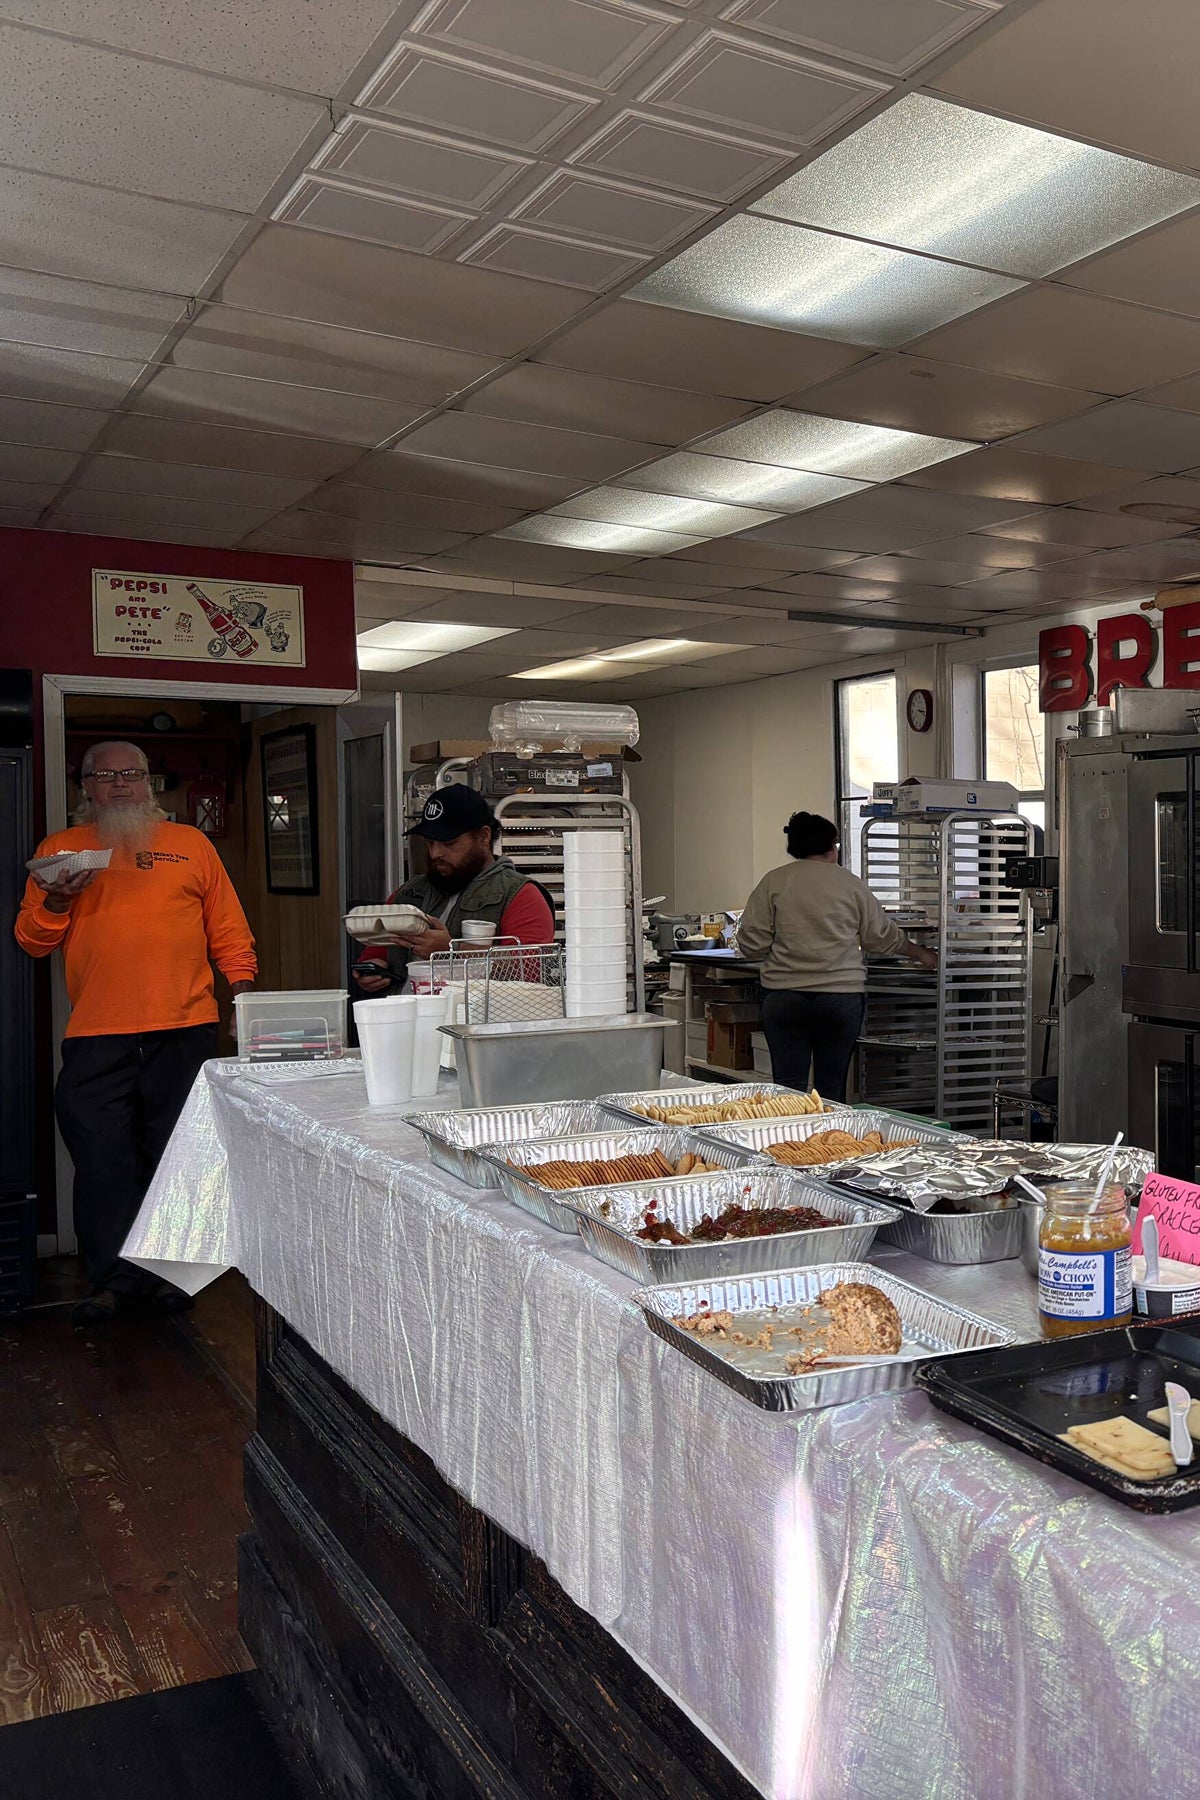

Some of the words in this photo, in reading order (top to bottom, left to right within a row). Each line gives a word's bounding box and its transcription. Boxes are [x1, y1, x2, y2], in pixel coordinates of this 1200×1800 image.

[1145, 1180, 1185, 1202] GLUTEN
[1048, 1257, 1097, 1271] Campbell's
[1063, 1273, 1096, 1283] CHOW
